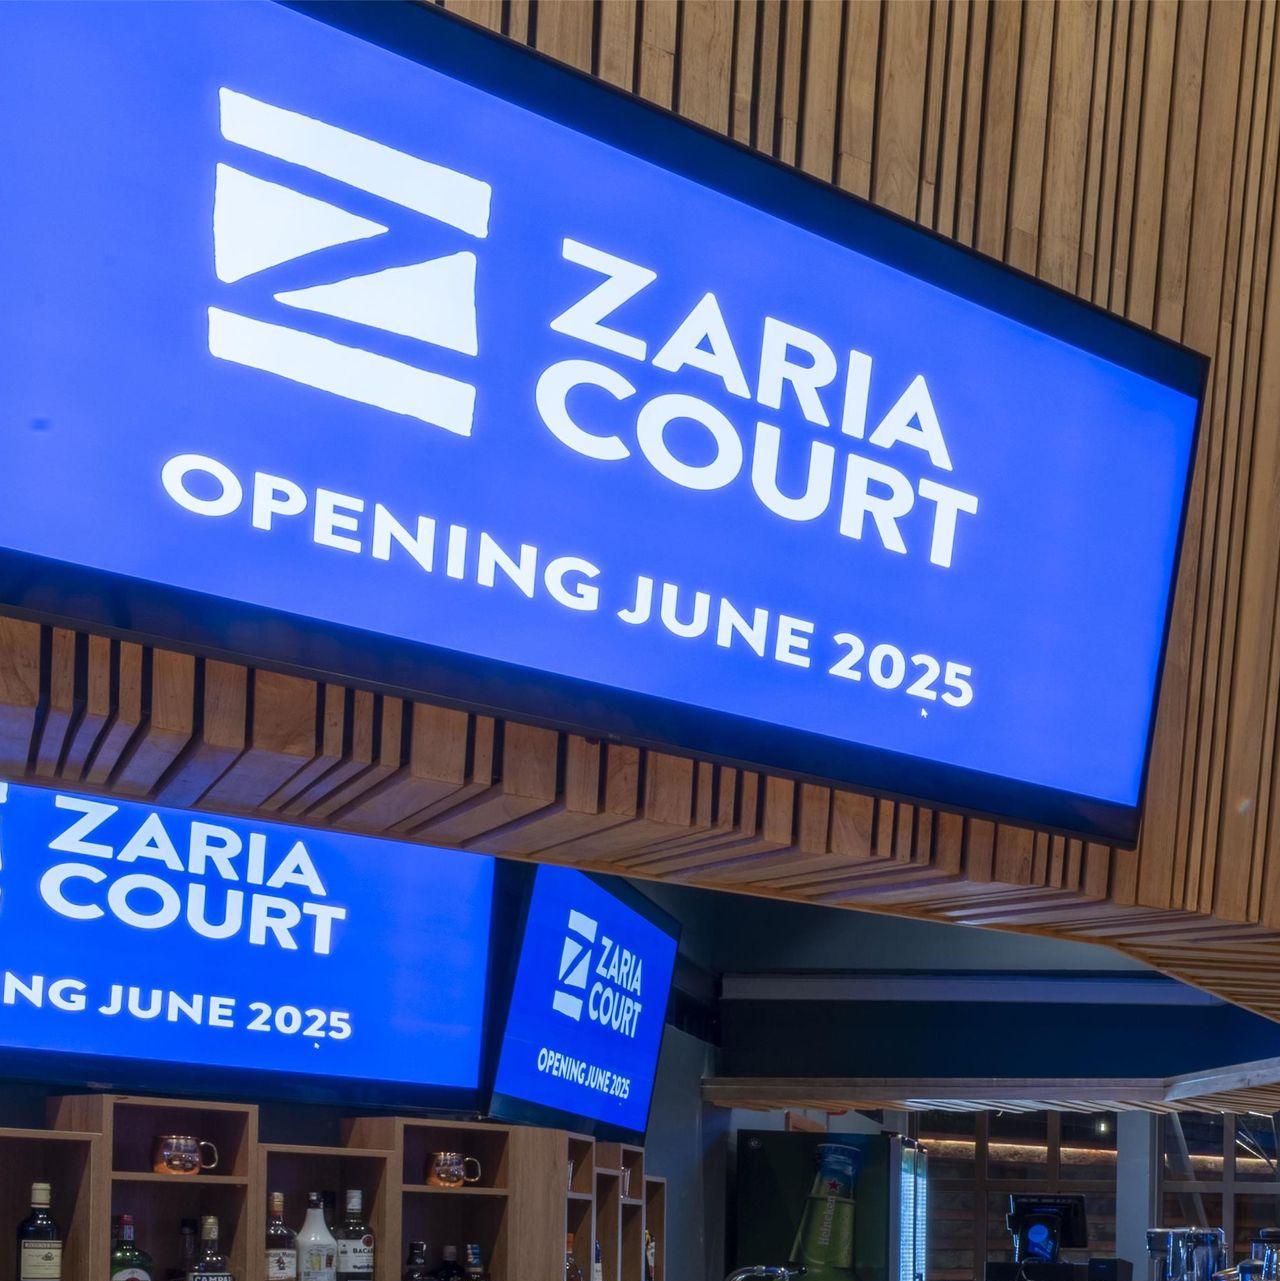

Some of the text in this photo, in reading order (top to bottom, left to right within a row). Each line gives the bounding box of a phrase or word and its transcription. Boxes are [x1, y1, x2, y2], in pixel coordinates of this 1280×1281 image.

[549, 238, 954, 472] ZARIA
[535, 358, 978, 569] COURT
[160, 453, 973, 709] OPENING JUNE 2025
[48, 795, 327, 896] ZARIA
[40, 862, 346, 955] COURT
[588, 981, 643, 1038] COURT
[596, 935, 643, 996] ZARIA
[98, 985, 236, 1028] JUNE
[246, 1002, 352, 1040] 2025
[538, 1047, 631, 1100] OPENING JUNE 2025
